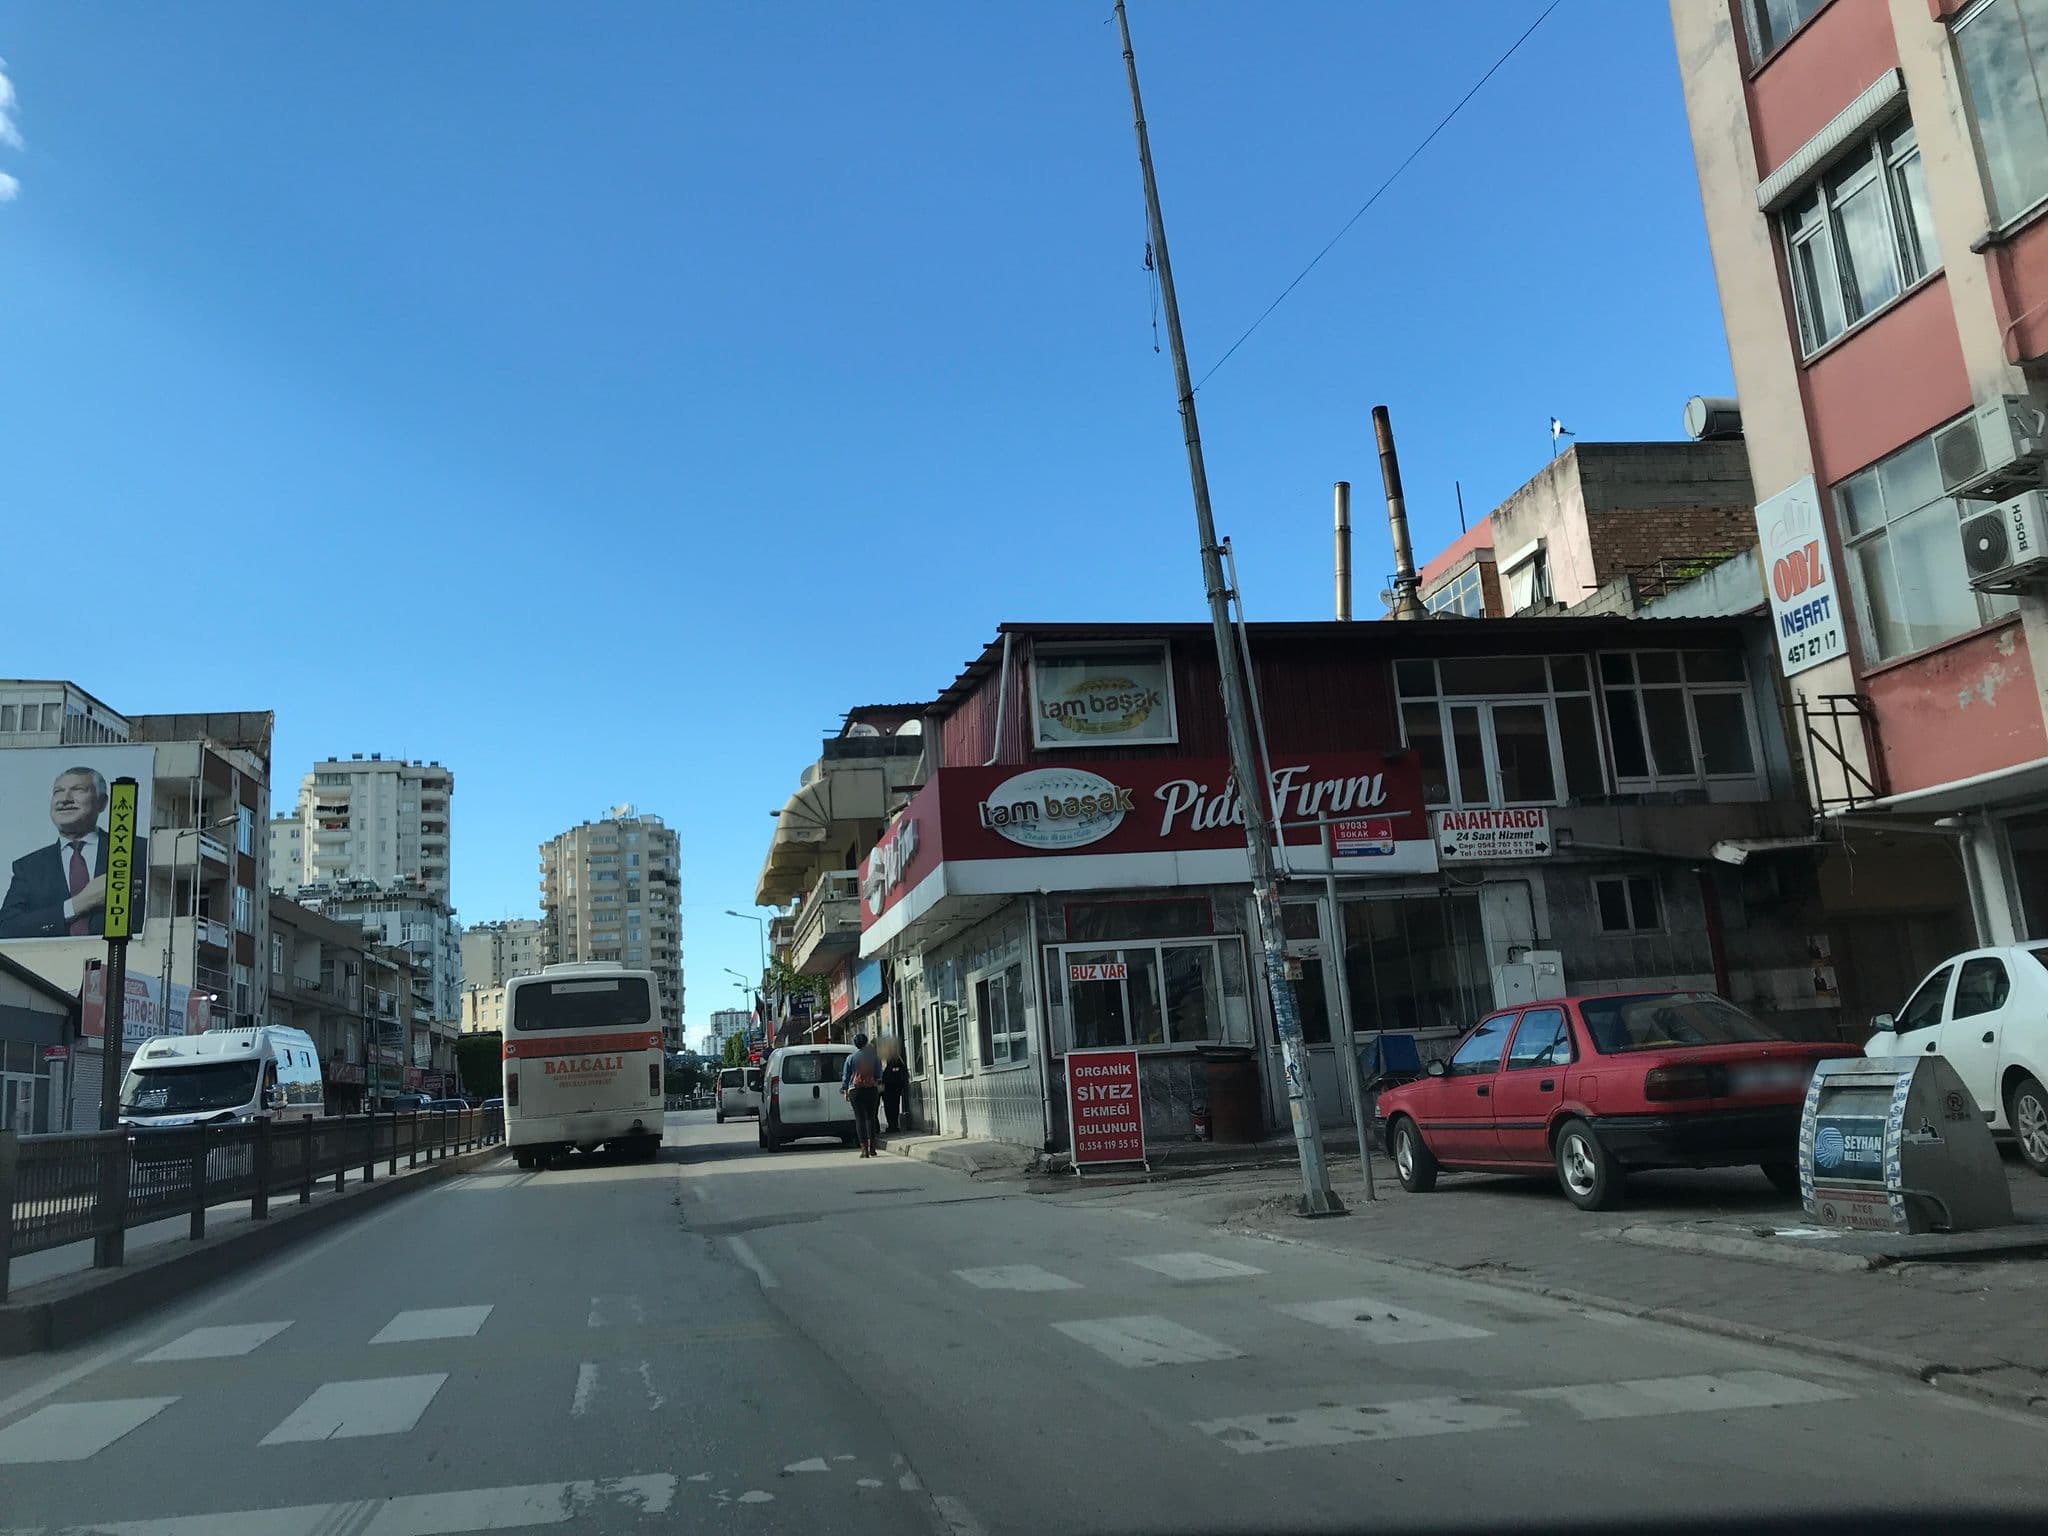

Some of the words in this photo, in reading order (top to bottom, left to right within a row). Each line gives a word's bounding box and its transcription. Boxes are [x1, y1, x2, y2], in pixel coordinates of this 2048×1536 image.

[2012, 504, 2029, 552] BOSCH
[1773, 539, 1825, 602] ODZ
[1788, 643, 1806, 663] 457
[1809, 637, 1820, 657] 27
[1825, 630, 1836, 650] 17
[1040, 699, 1086, 720] tam
[1089, 688, 1161, 713] başak
[979, 801, 1039, 828] tam
[1043, 786, 1135, 819] başak
[1443, 810, 1544, 831] ANAHTARCI
[113, 813, 129, 854] YAYA
[1457, 832, 1469, 841] 24
[1472, 831, 1495, 840] Saat
[1499, 830, 1534, 840] Hizmet
[1072, 965, 1097, 980] BUZ
[1101, 964, 1126, 978] VAR
[544, 1056, 624, 1074] BALCALI
[1075, 1063, 1132, 1077] ORGANİK
[1077, 1083, 1133, 1101] SİYEZ
[1082, 1103, 1130, 1117] EKMEĞİ
[1078, 1122, 1138, 1135] BULUNUR
[1105, 1141, 1116, 1149] 119
[1119, 1140, 1129, 1148] 55
[1131, 1139, 1139, 1147] 15
[1844, 1135, 1882, 1151] SEYHAN
